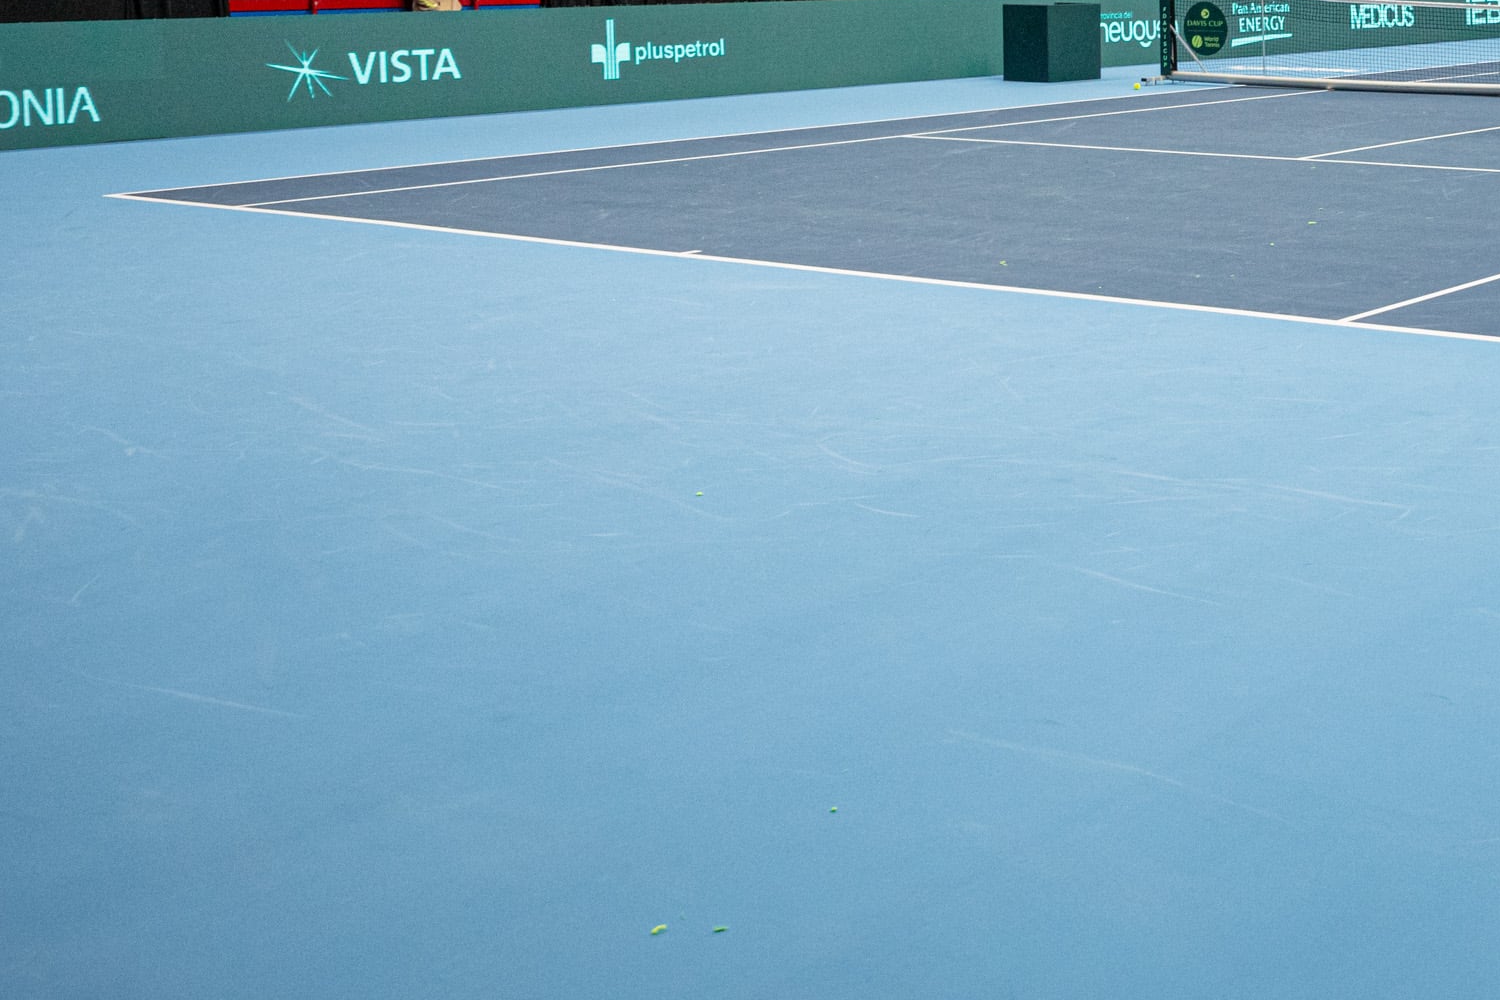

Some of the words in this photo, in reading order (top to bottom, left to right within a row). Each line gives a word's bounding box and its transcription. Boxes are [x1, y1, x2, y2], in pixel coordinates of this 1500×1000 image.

[1232, 2, 1249, 15] Pan
[1350, 3, 1415, 30] MEDICUS
[1187, 20, 1207, 28] DAVIS
[1208, 20, 1224, 28] CUP
[1239, 15, 1285, 32] ENERGY
[634, 37, 726, 65] pluspetrol
[347, 47, 463, 86] VISTA
